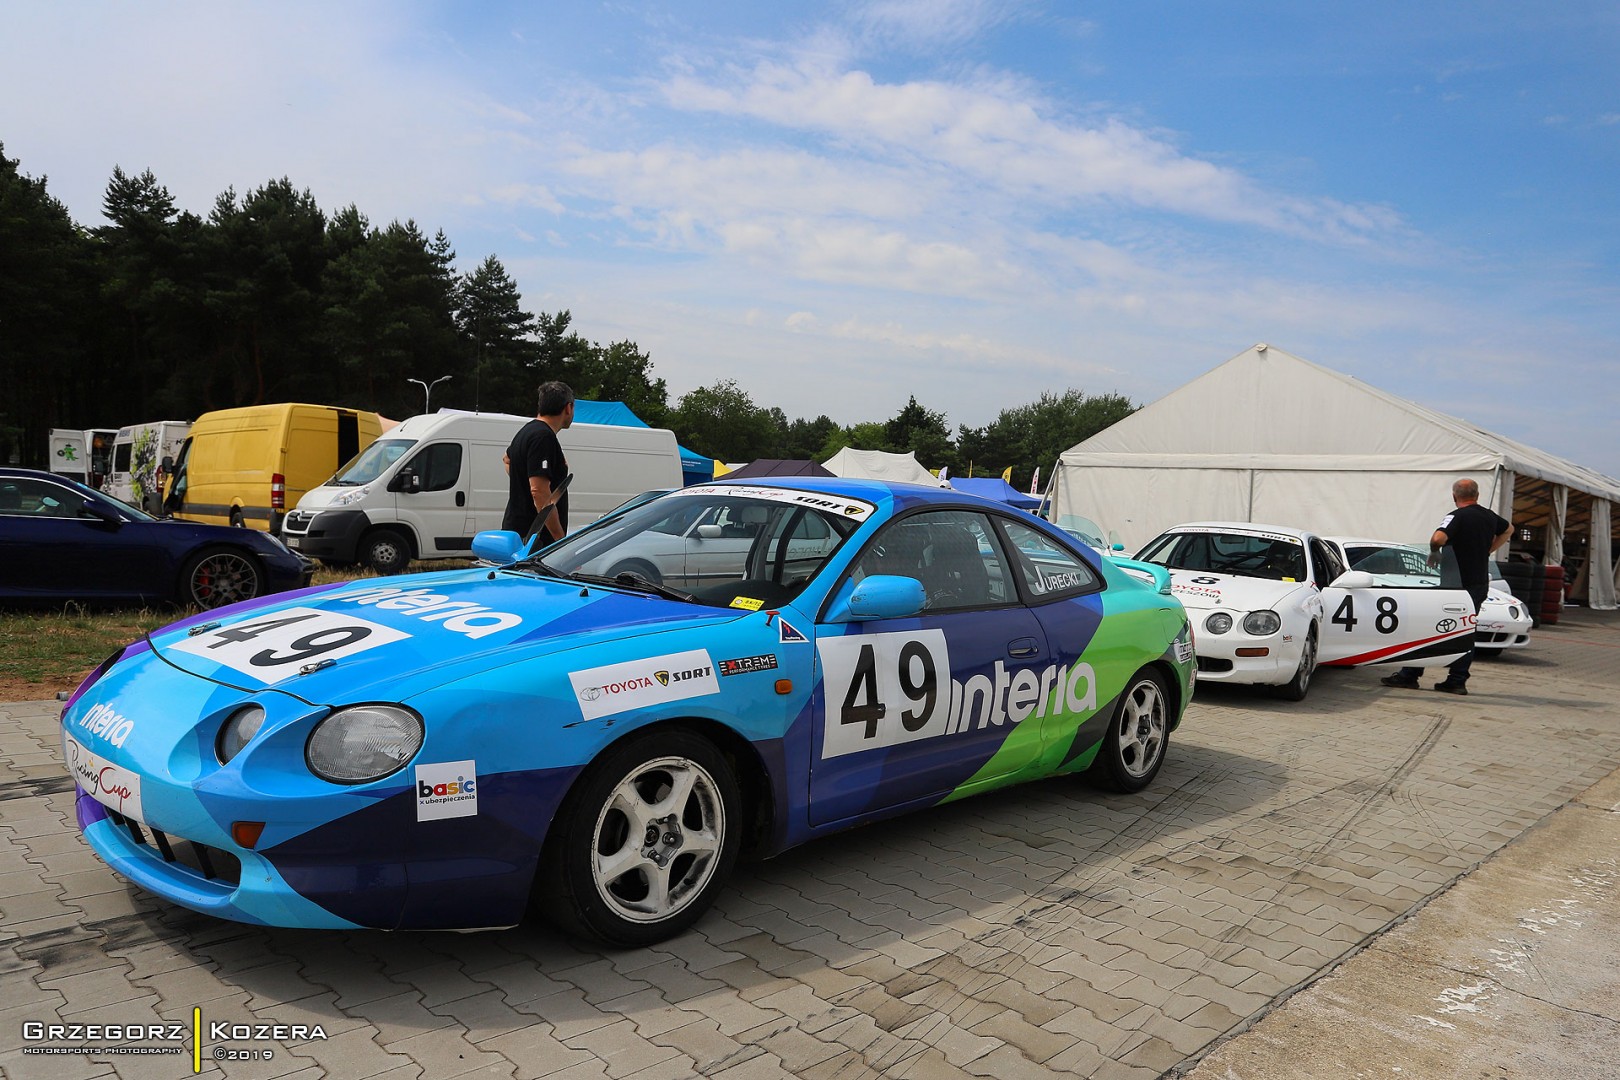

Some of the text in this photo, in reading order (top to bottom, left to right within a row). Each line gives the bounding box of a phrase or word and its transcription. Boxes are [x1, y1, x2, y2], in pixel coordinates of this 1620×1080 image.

[1172, 585, 1221, 595] OYOTA
[206, 613, 373, 667] 49
[601, 667, 711, 695] TOYOTA SORT
[840, 640, 938, 739] 49
[418, 775, 475, 798] basic
[425, 794, 475, 805] ubezpieczenia
